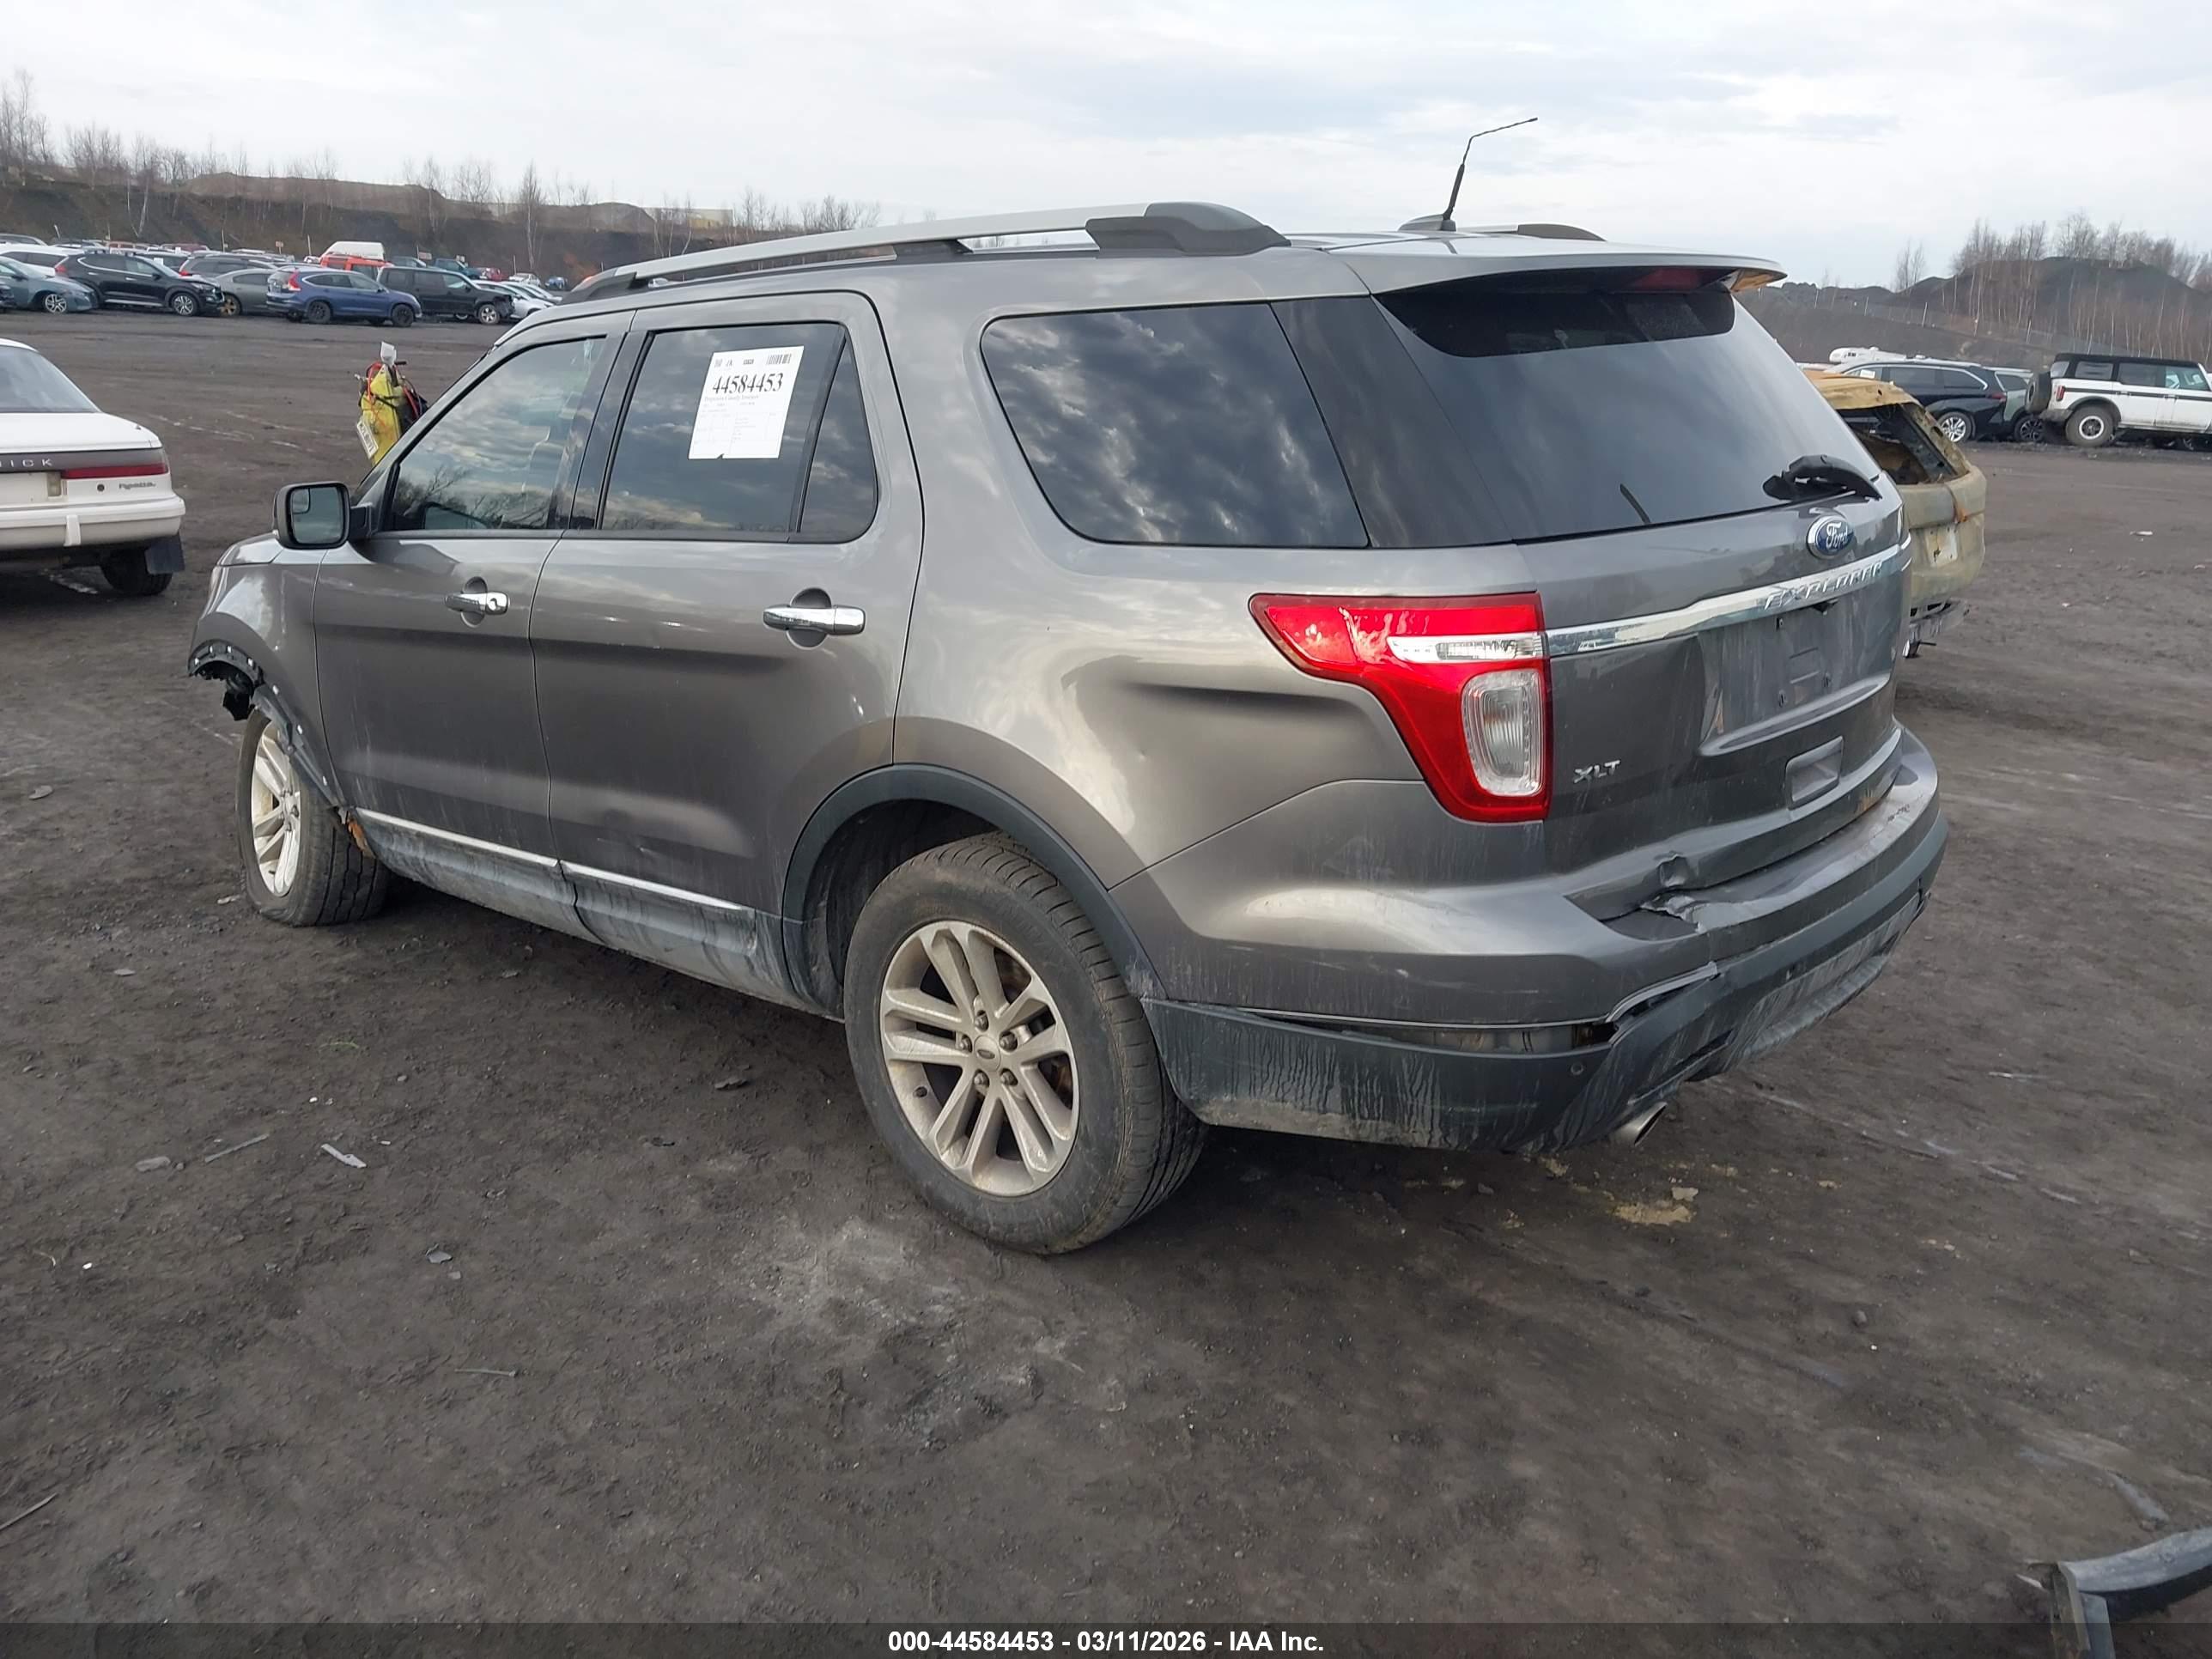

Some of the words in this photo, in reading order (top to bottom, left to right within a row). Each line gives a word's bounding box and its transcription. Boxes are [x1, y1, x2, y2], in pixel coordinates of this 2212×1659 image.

[712, 372, 784, 395] 44584453
[0, 459, 54, 468] ICK
[1825, 520, 1849, 550] Ford
[1573, 759, 1621, 784] XLT
